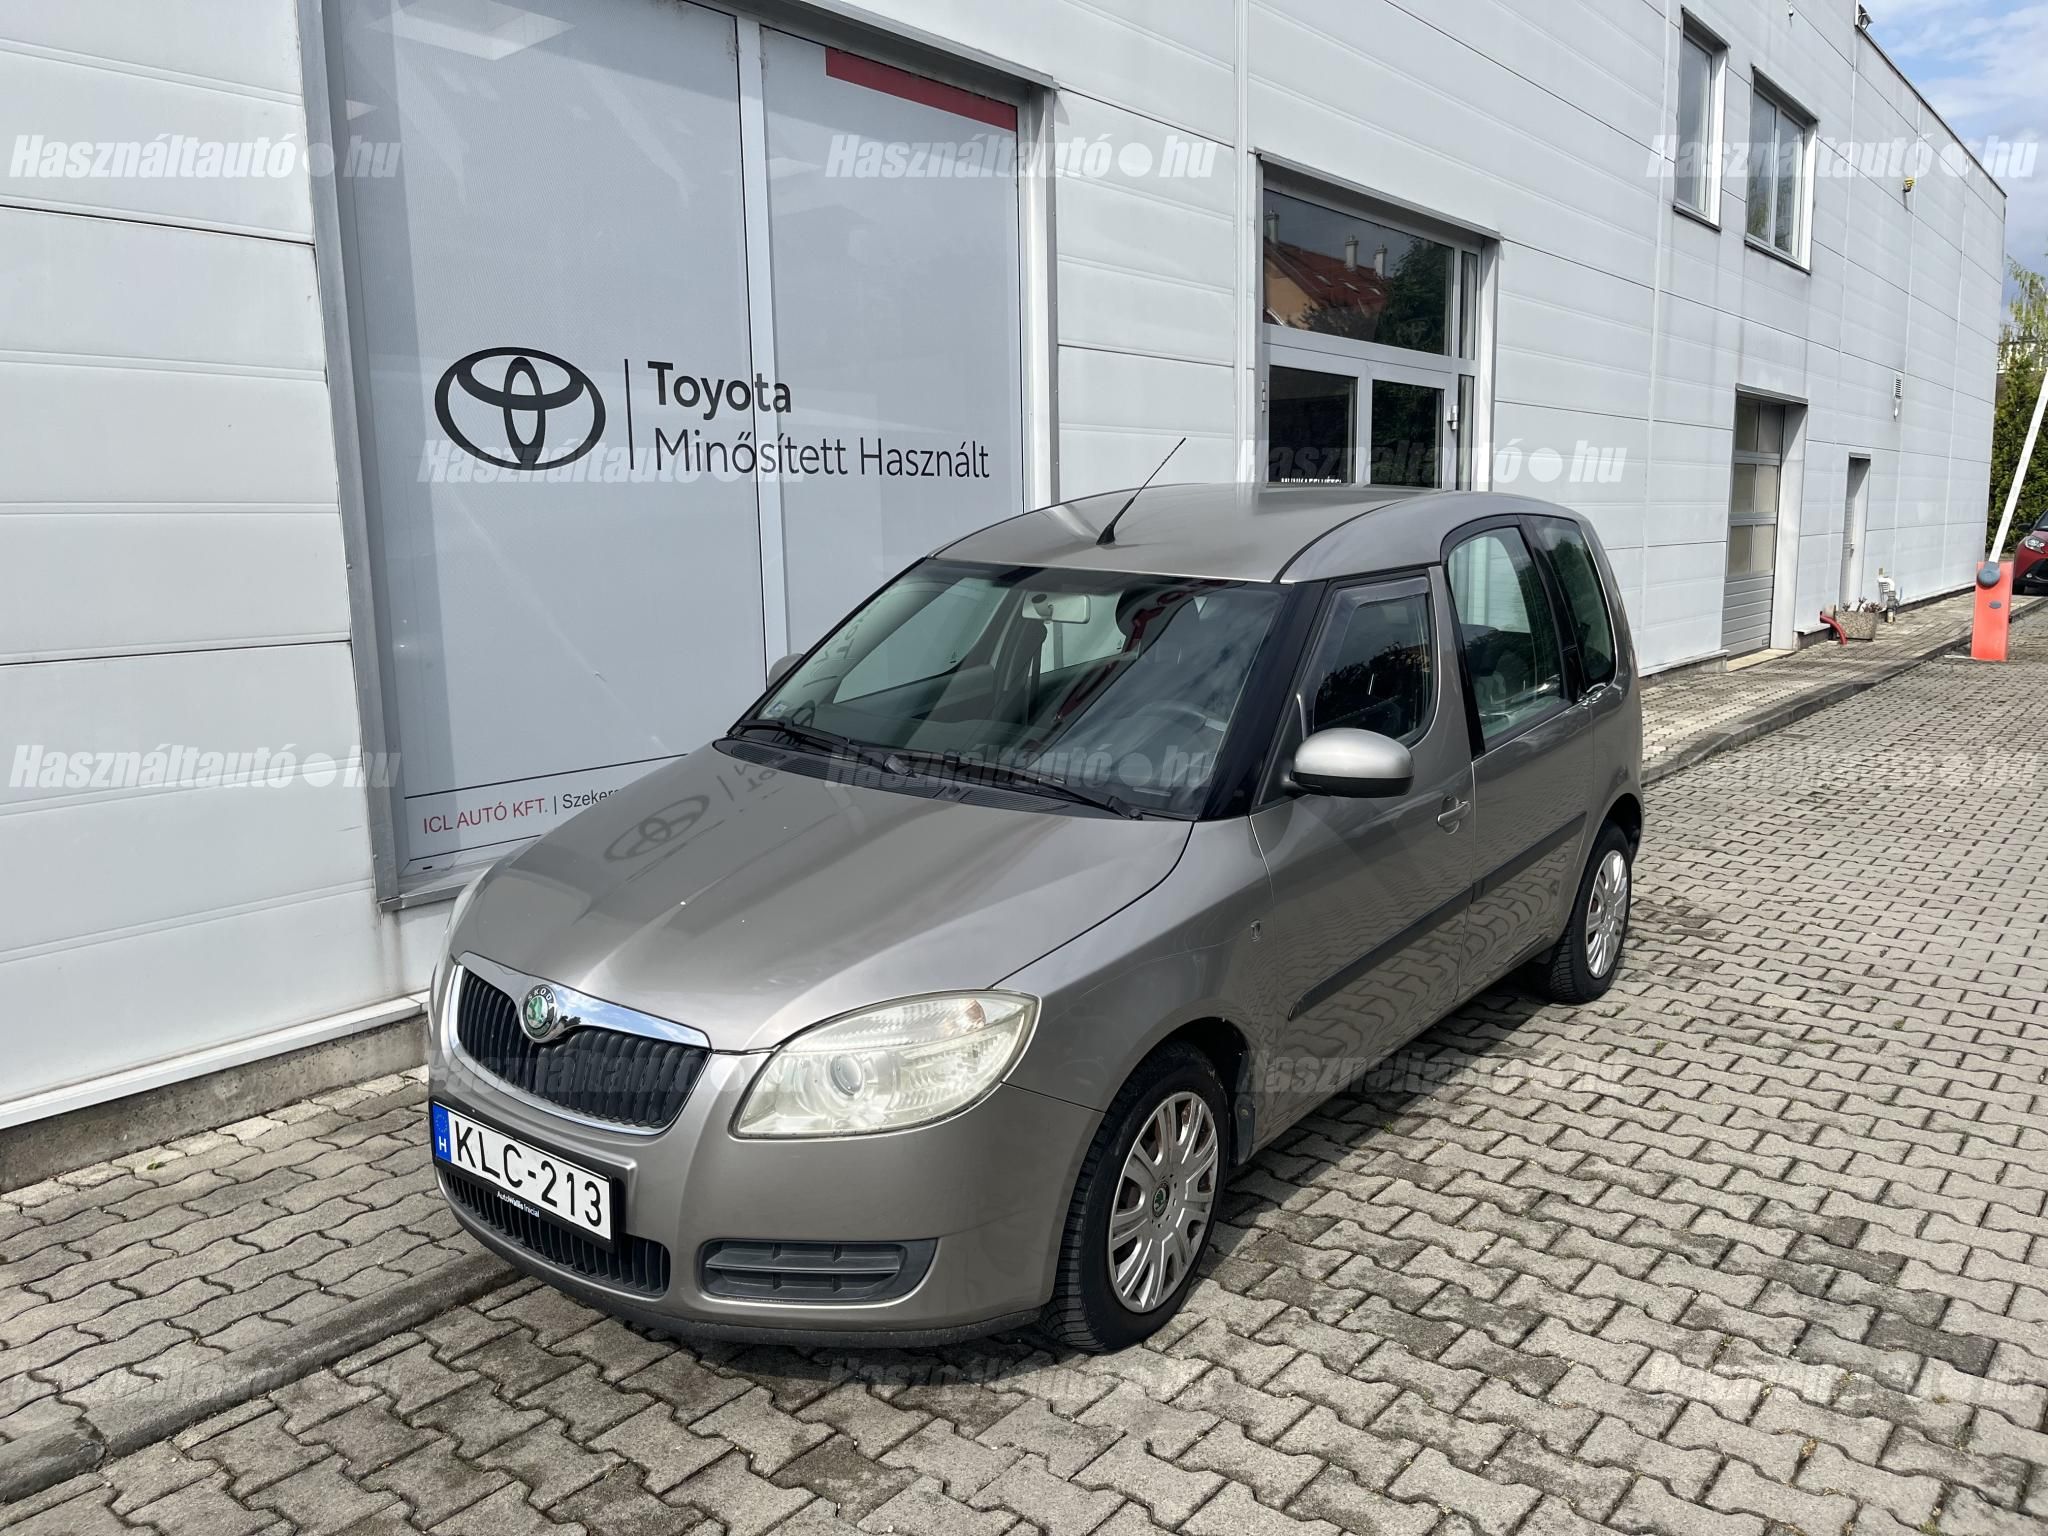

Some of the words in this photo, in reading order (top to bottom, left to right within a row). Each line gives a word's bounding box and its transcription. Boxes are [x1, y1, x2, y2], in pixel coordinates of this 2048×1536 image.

[648, 361, 791, 420] Toyota
[654, 428, 848, 475] Minősített
[860, 437, 989, 478] Használt
[424, 814, 453, 834] ICL
[457, 802, 507, 828] AUTÓ
[513, 798, 548, 818] KFT.
[438, 1135, 447, 1153] H
[455, 1120, 602, 1228] KLC-213
